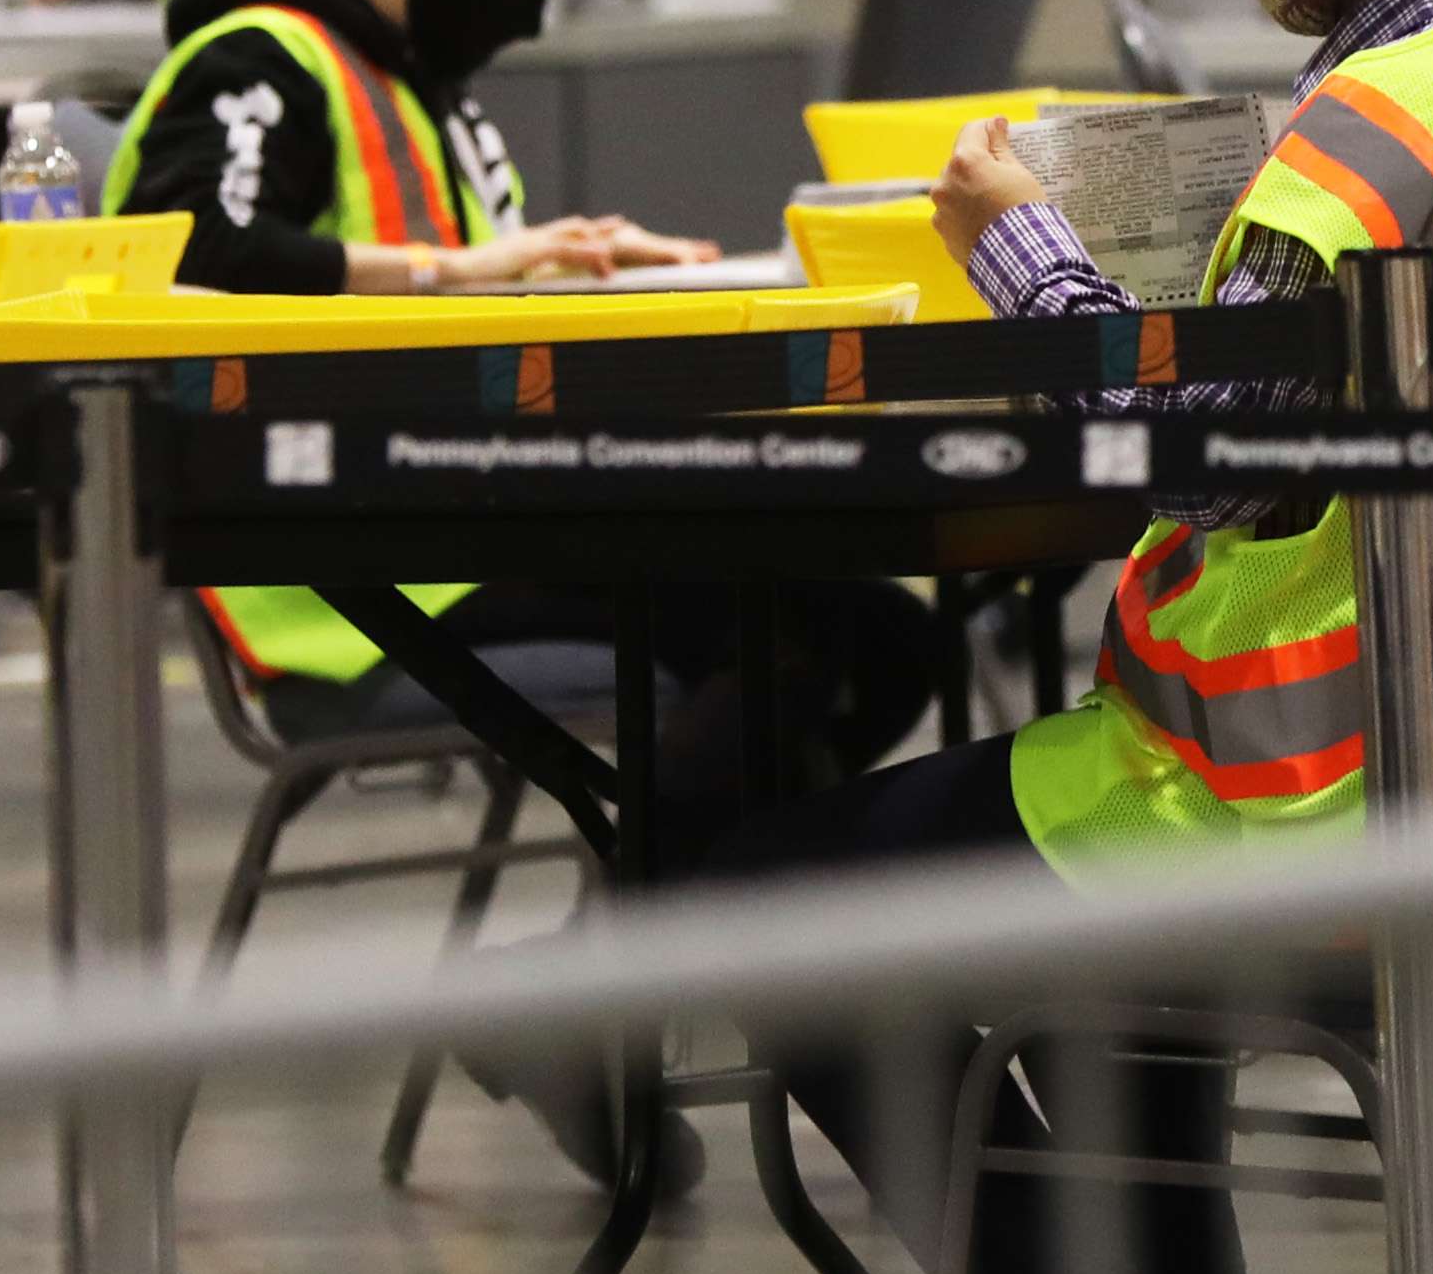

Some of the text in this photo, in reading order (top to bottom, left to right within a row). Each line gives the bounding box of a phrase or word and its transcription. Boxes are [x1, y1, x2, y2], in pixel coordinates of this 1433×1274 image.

[386, 432, 864, 473] Pennsylvania Convention Center
[1205, 431, 1403, 474] Pennsylvania
